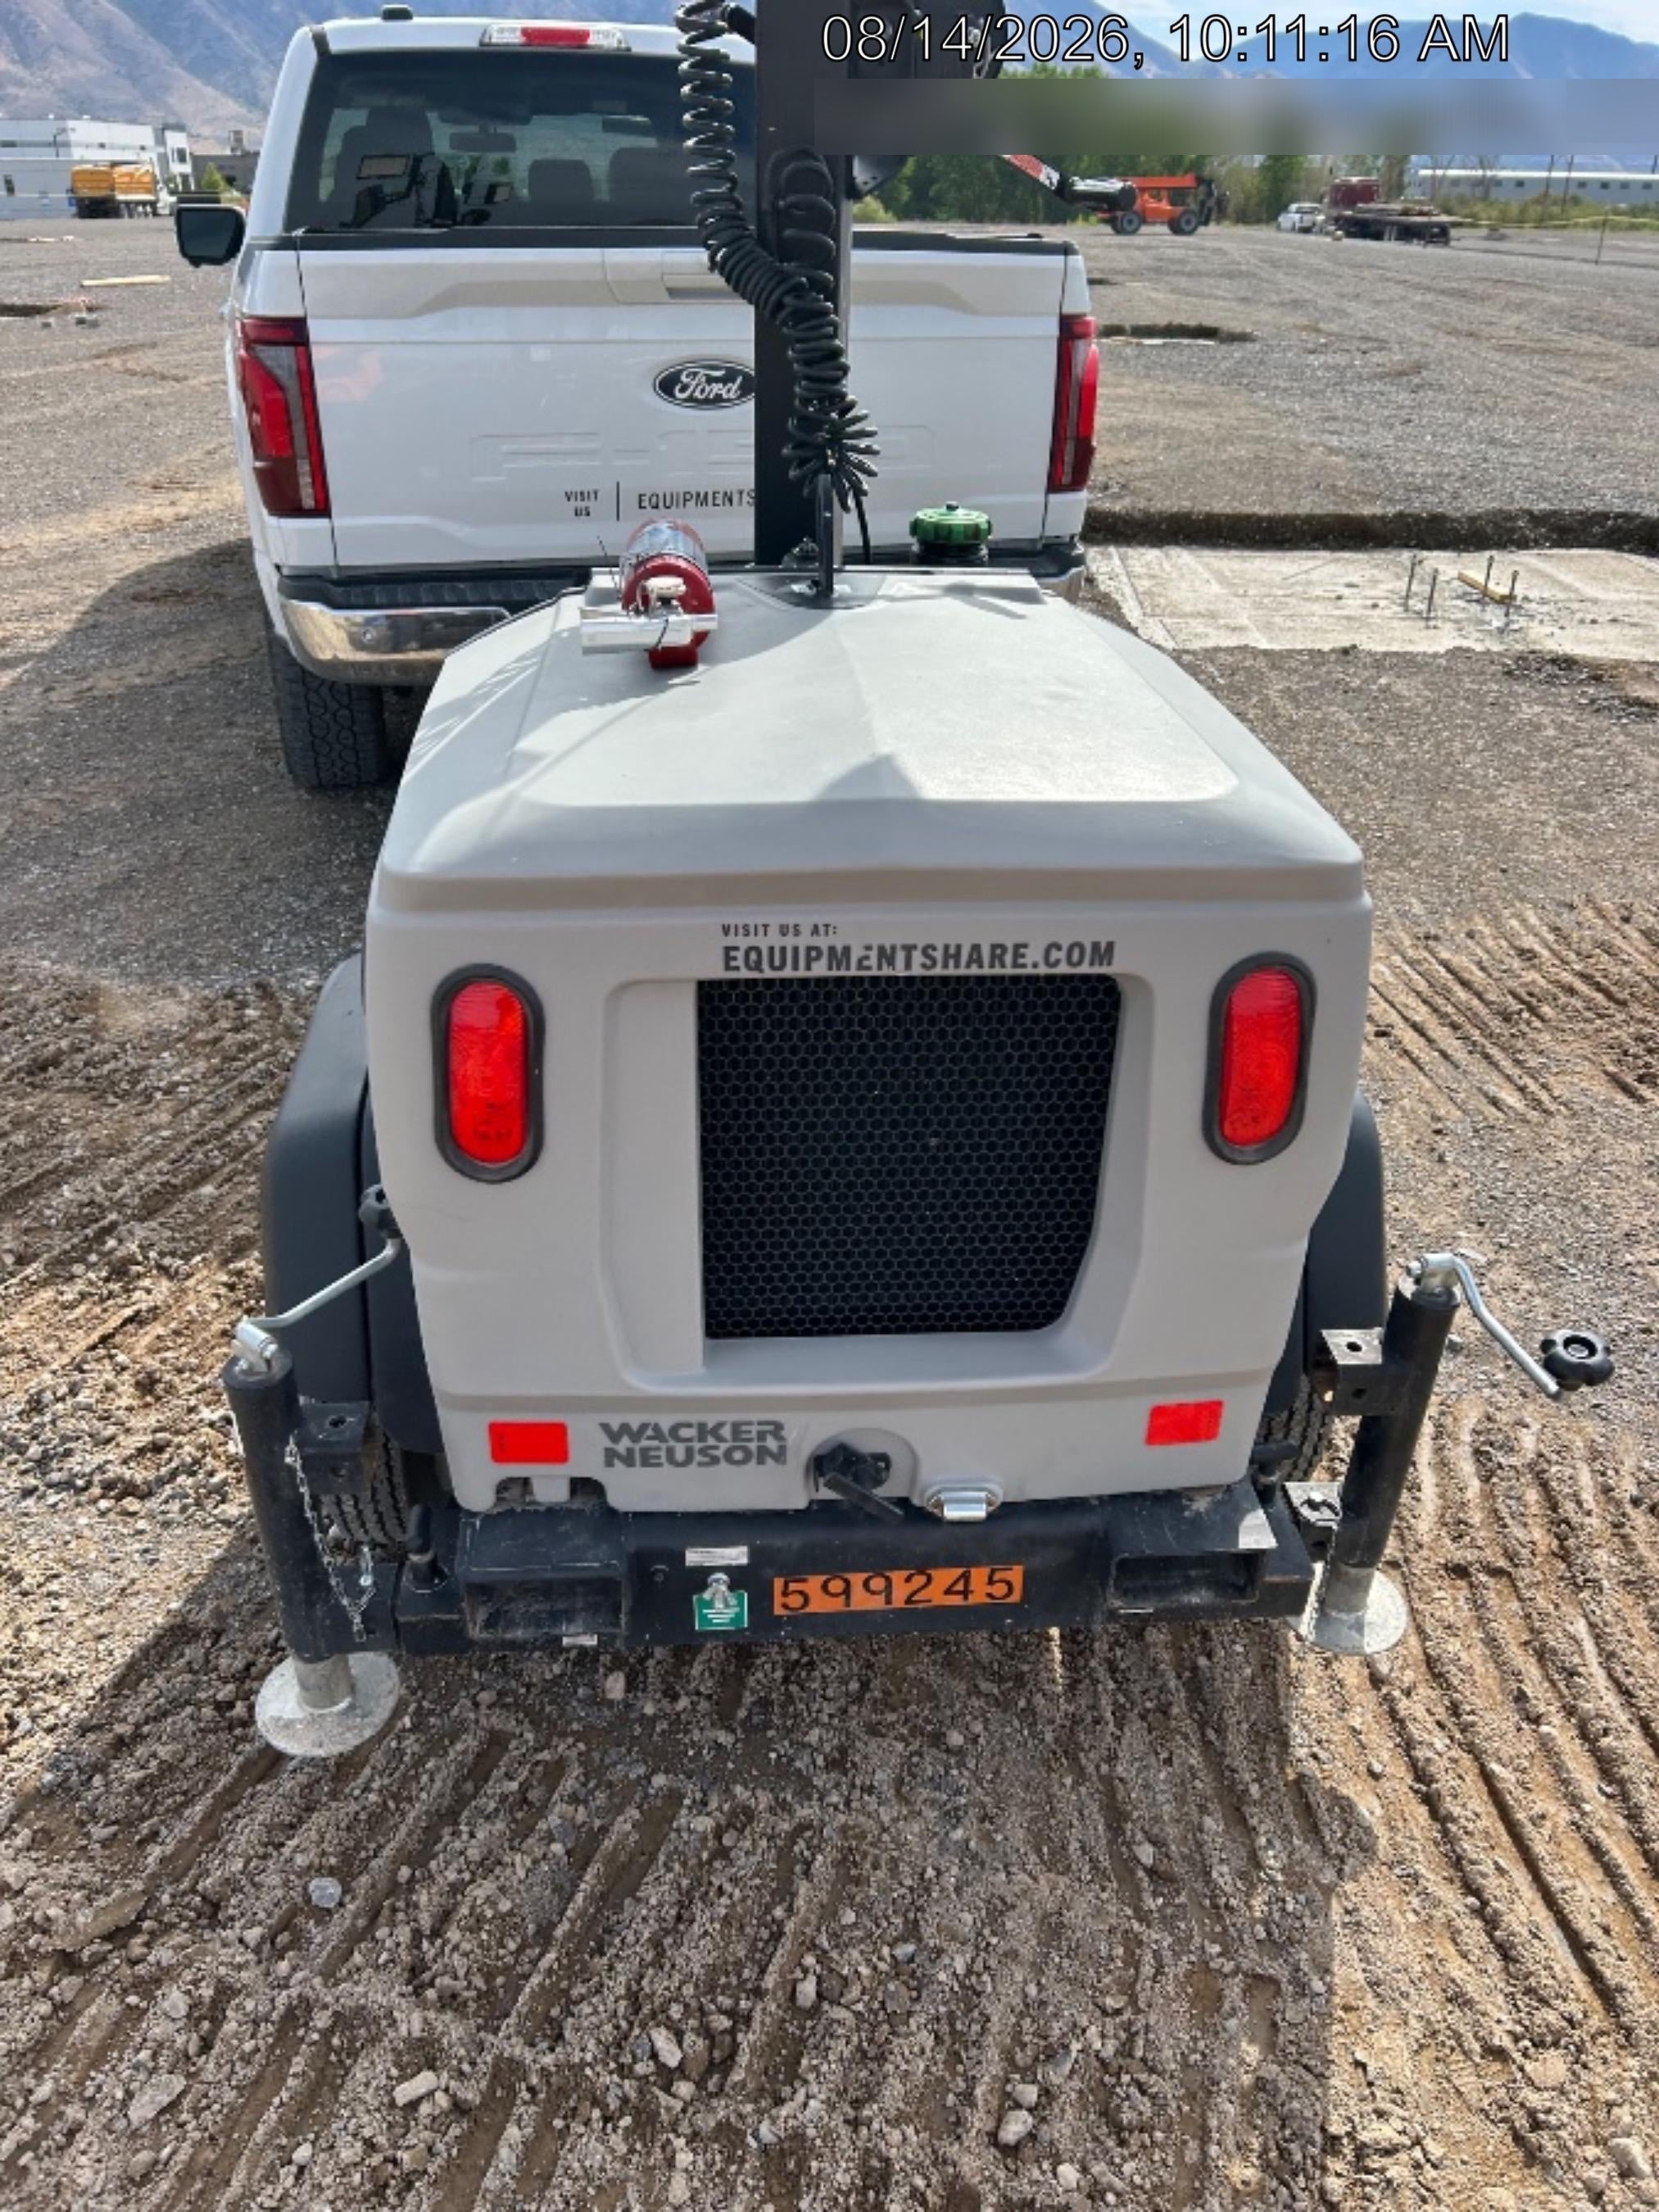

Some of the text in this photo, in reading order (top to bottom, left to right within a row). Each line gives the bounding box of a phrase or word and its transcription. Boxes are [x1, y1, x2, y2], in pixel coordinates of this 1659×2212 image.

[674, 369, 742, 400] Ford
[564, 489, 600, 502] VISIT
[574, 506, 591, 517] US
[722, 923, 838, 937] VISIT US AT:
[723, 941, 1116, 972] EQUIPMENTSHARE.COM
[599, 1420, 786, 1444] WACKER
[604, 1444, 787, 1468] NEUSON
[780, 1566, 1015, 1611] 599245
